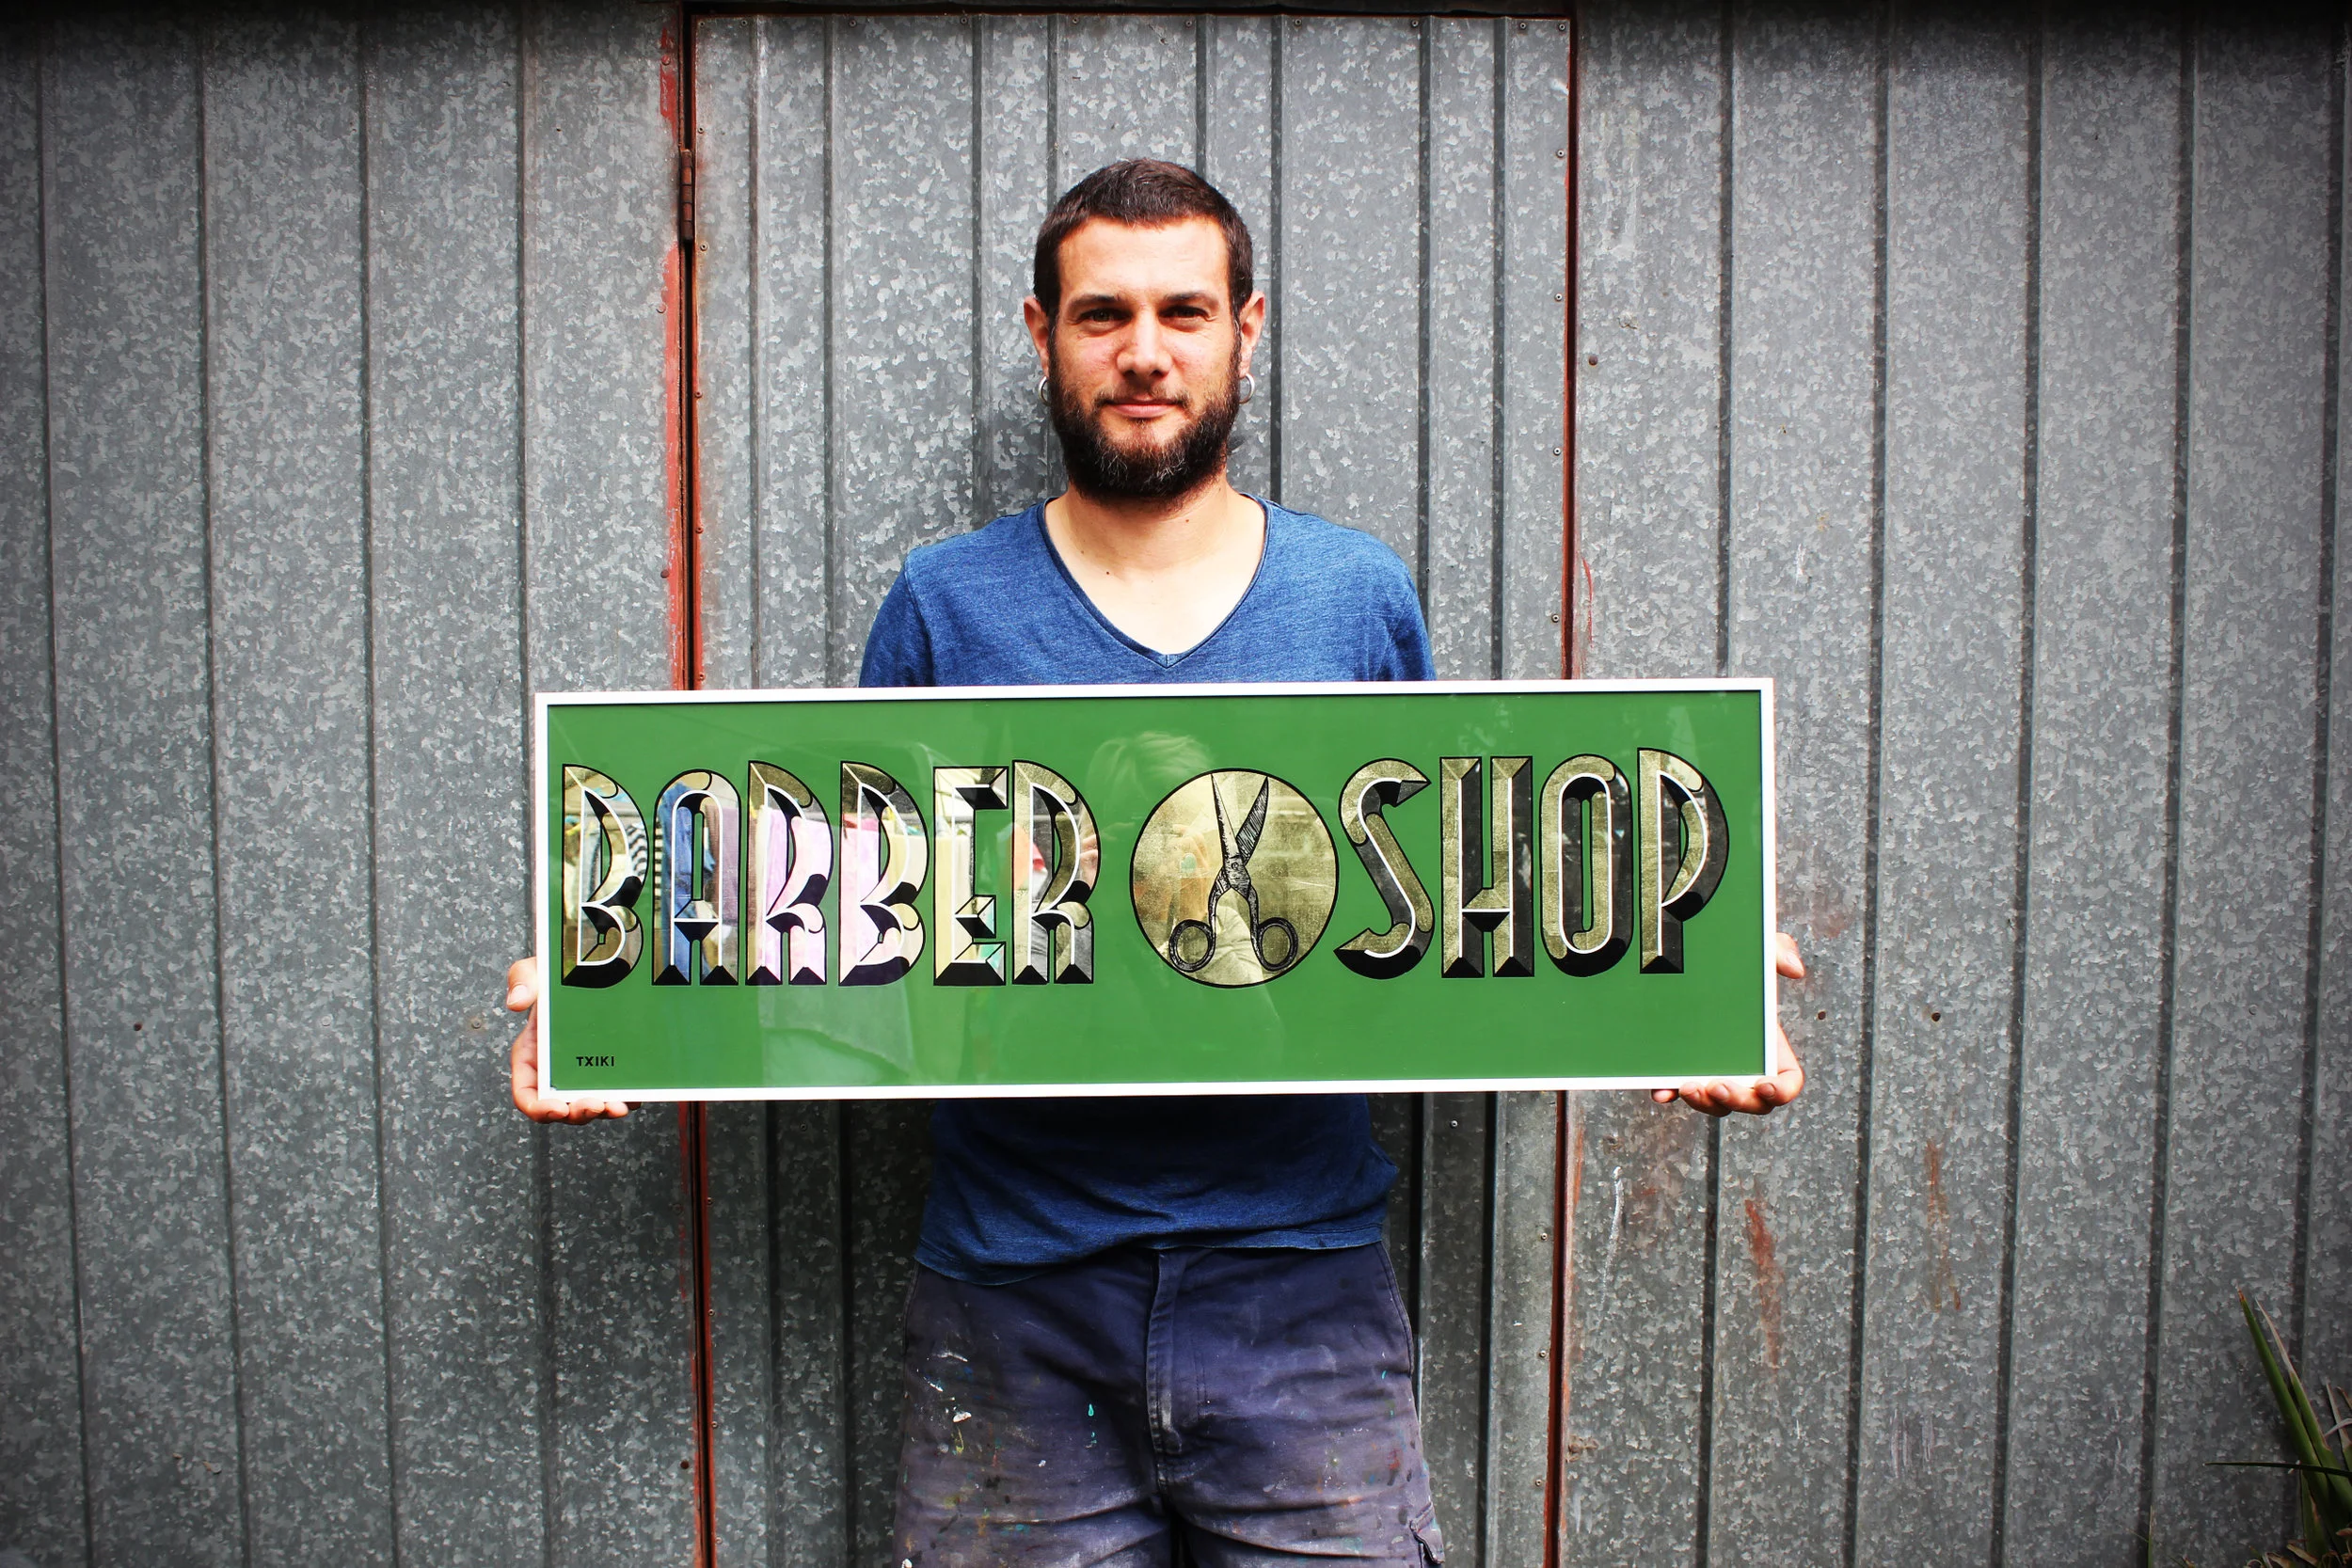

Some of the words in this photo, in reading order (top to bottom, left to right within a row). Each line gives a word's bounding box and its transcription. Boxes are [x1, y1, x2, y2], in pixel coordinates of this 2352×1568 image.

[562, 760, 1102, 989] BARBER
[1333, 747, 1729, 980] SHOP
[576, 1055, 615, 1067] TXIKI
